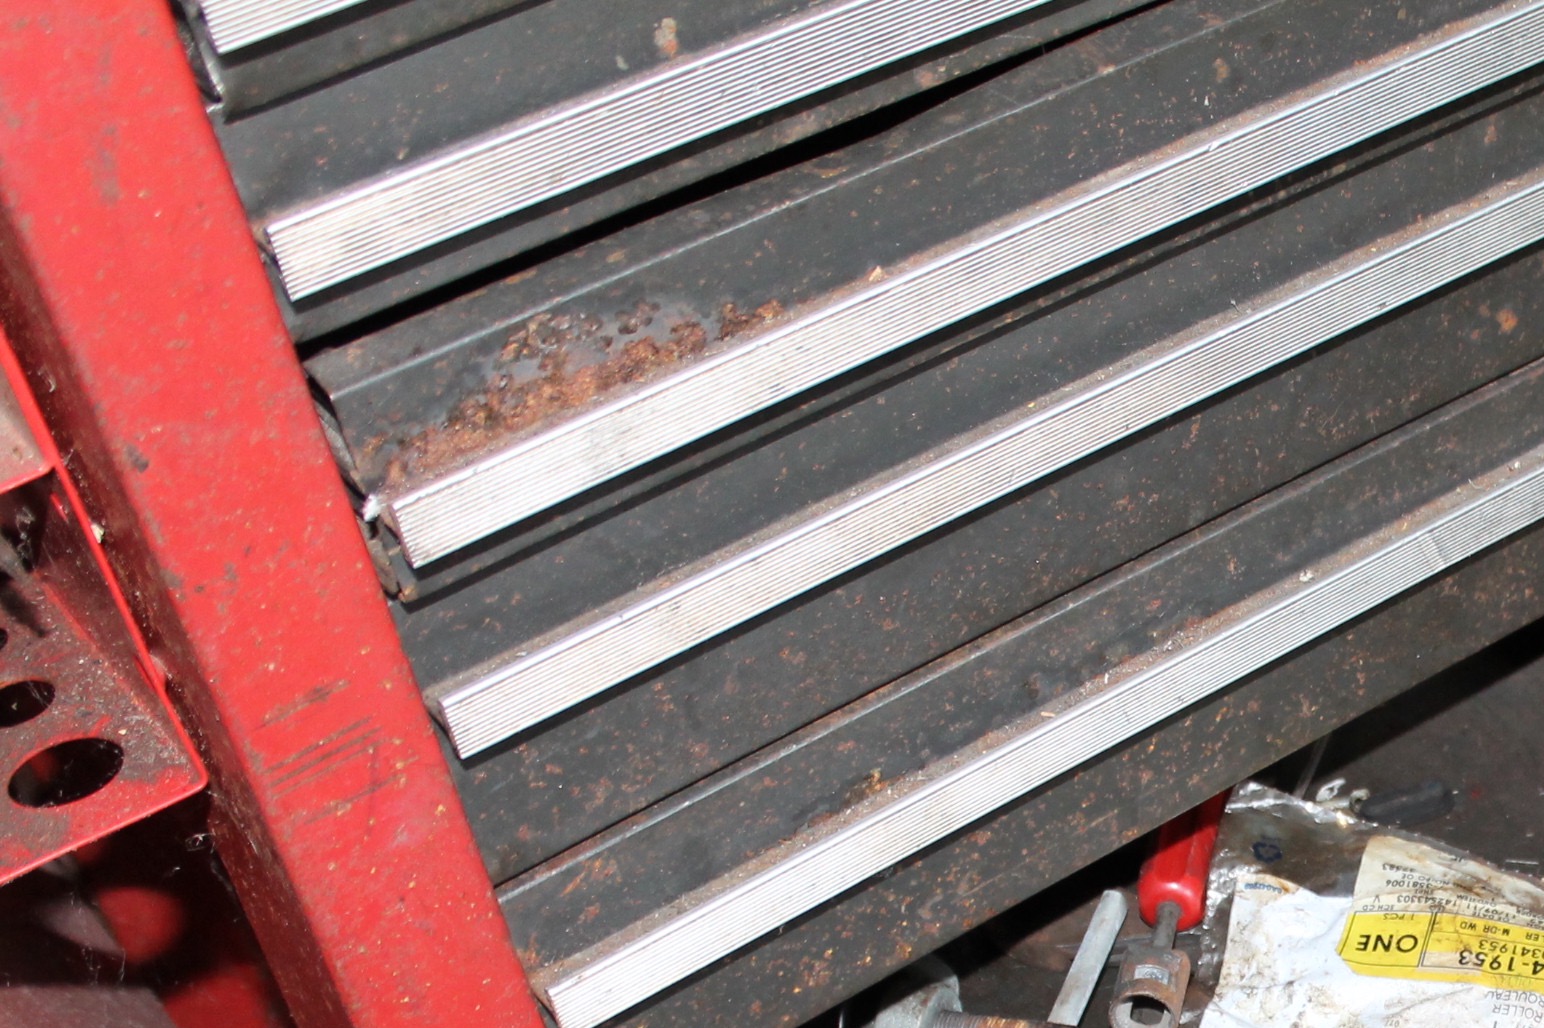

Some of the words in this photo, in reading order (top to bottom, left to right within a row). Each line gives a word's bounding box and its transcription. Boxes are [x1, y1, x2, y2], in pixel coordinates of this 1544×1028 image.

[1458, 920, 1477, 933] WD
[1354, 934, 1418, 954] ONE
[1492, 1004, 1543, 1023] ROLLER
